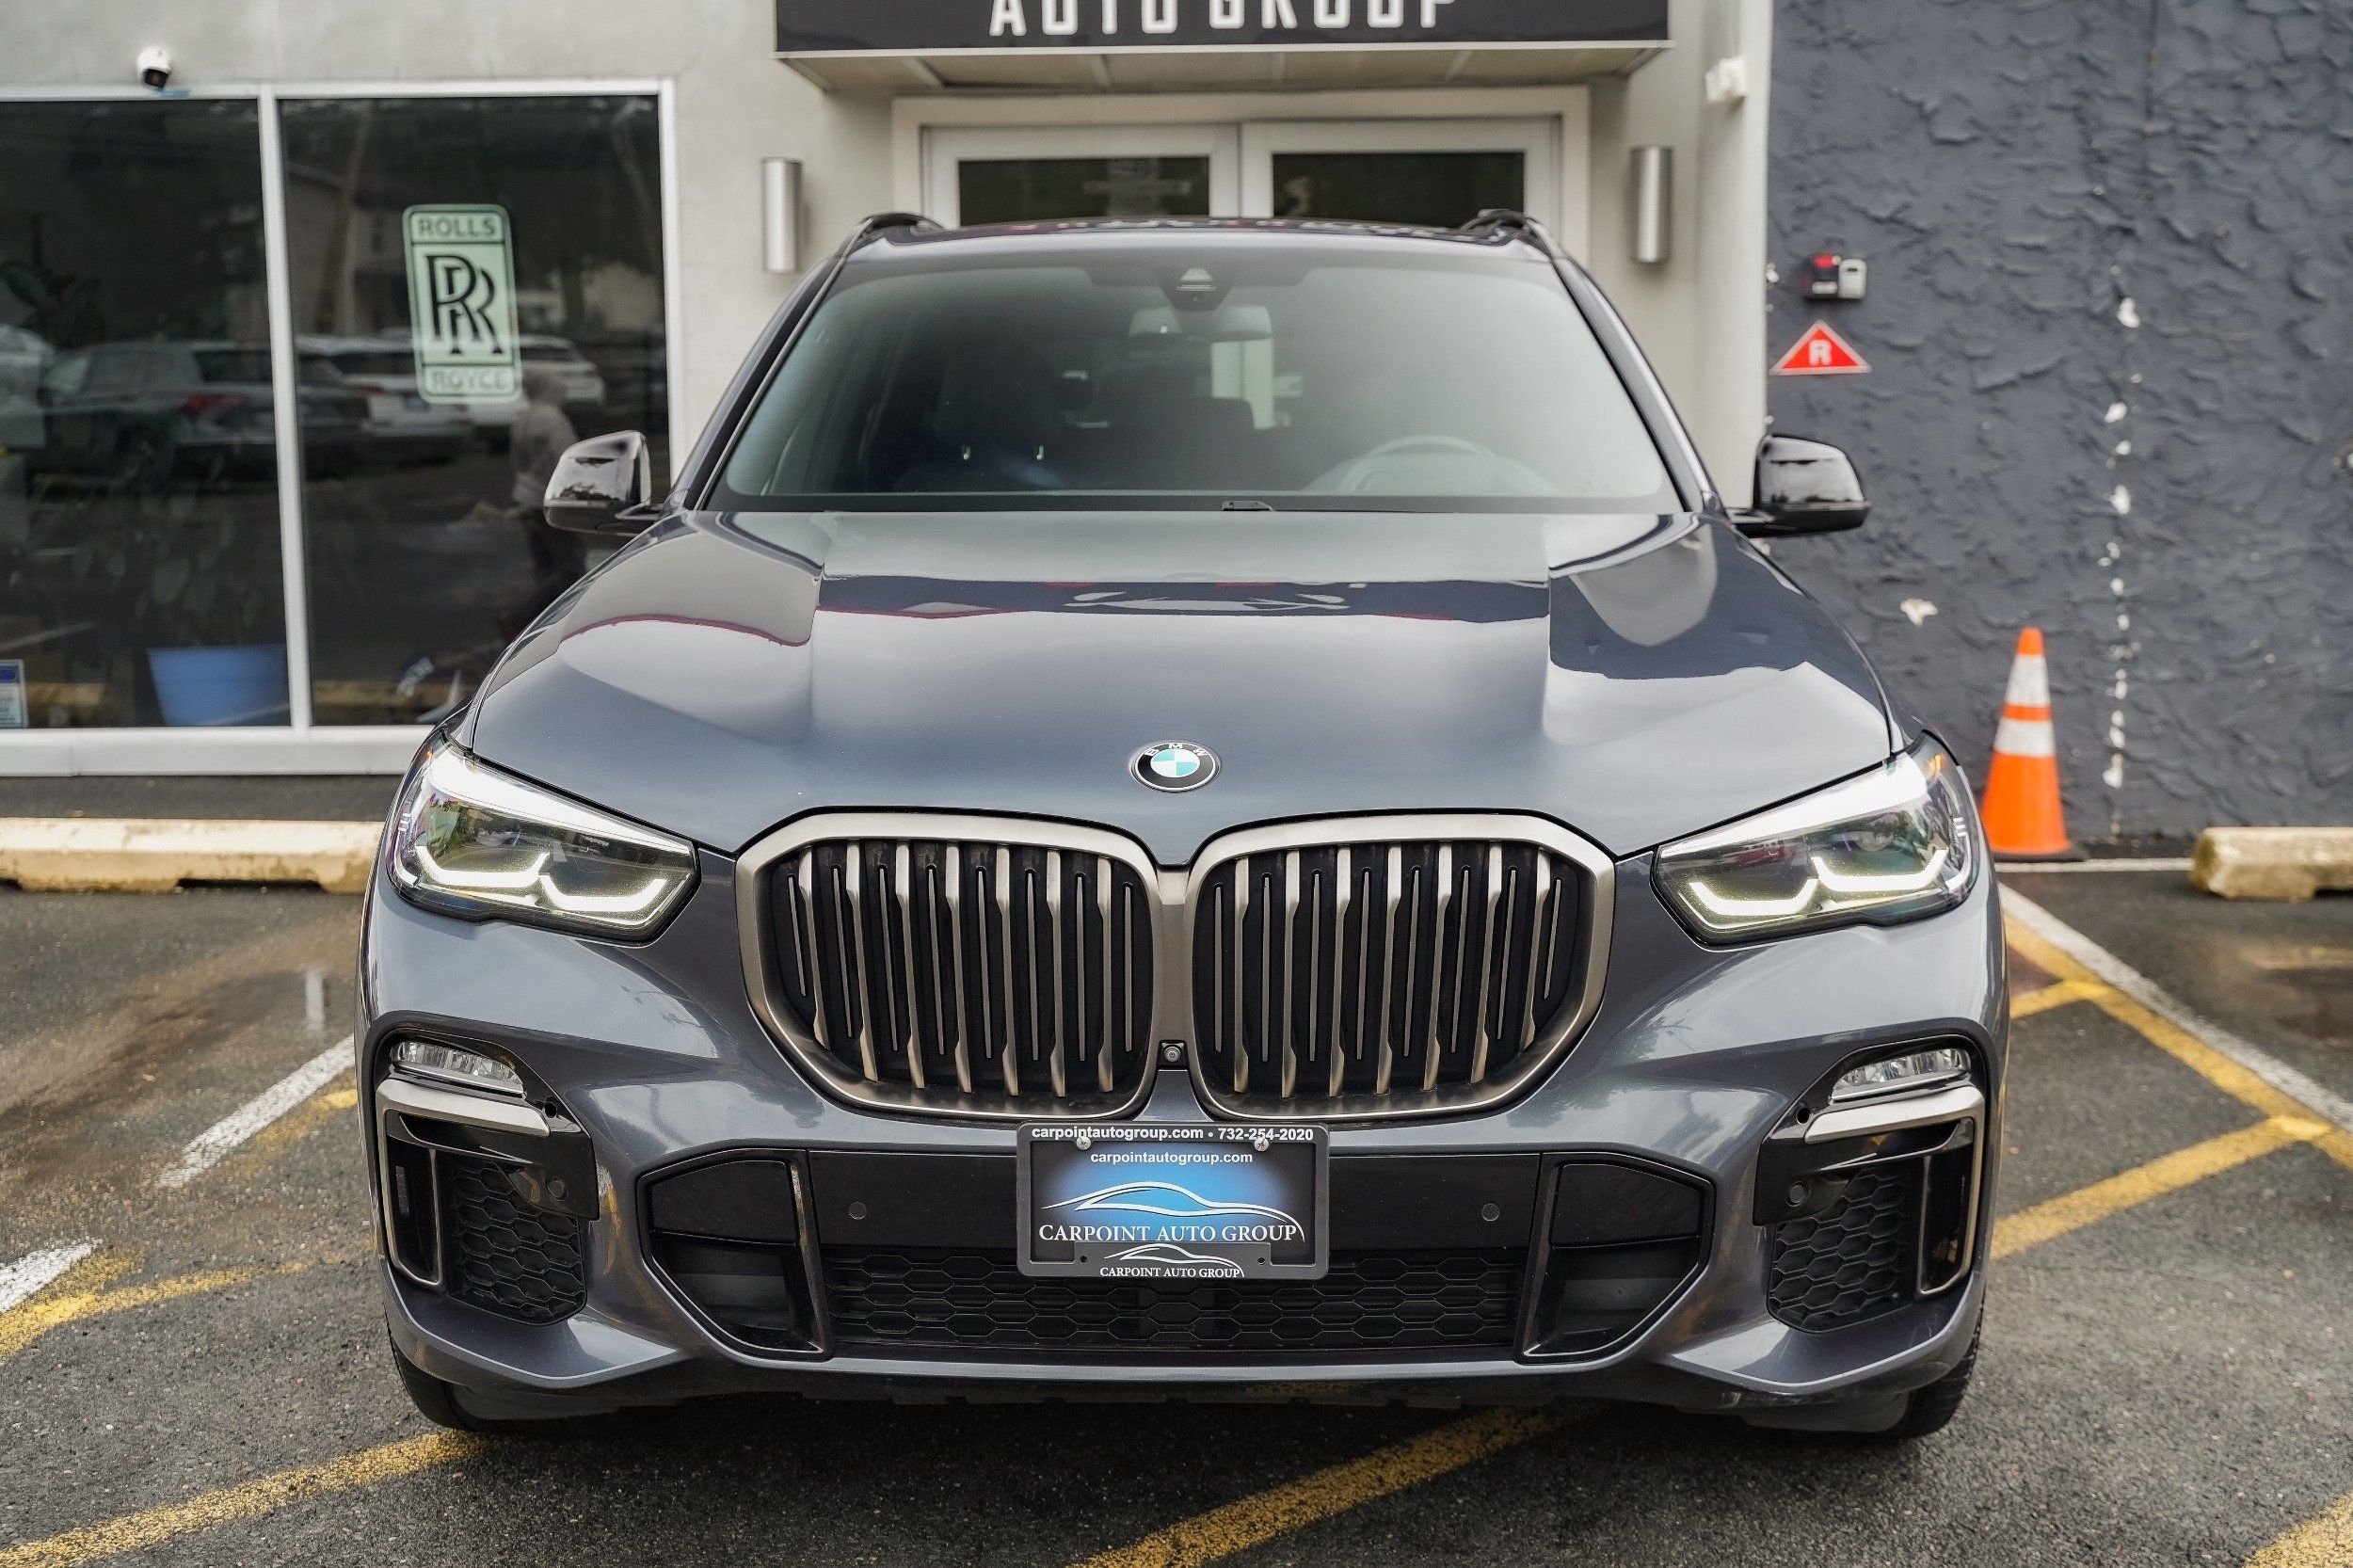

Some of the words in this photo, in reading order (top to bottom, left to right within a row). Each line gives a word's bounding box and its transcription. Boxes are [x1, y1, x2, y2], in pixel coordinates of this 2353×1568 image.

[988, 0, 1177, 37] AUTO
[418, 216, 497, 236] ROLLS
[1032, 1126, 1204, 1141] carpointautogroup.com
[1217, 1128, 1314, 1141] 732-254-2020
[1090, 1151, 1253, 1166] carpointautogroup.com
[1038, 1224, 1151, 1241] CARPOINT
[1156, 1225, 1216, 1241] AUTO
[1222, 1224, 1297, 1241] GROUP
[1099, 1267, 1161, 1277] CARPOINT
[1163, 1268, 1196, 1278] AUTO
[1198, 1268, 1241, 1278] GROUP
